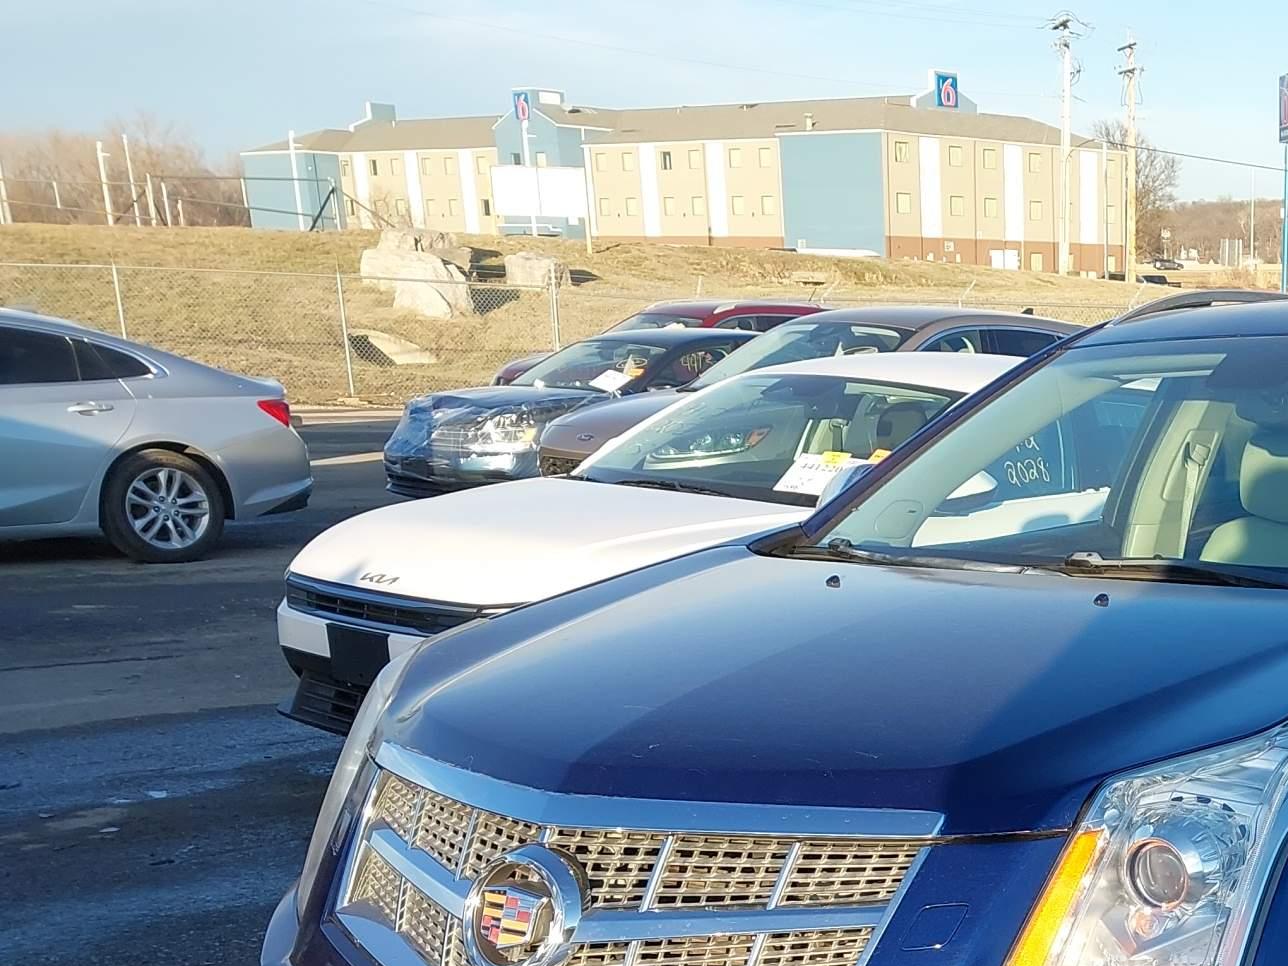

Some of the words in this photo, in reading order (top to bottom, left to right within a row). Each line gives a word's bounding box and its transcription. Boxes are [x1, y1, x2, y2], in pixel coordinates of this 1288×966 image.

[941, 78, 956, 106] 6
[1004, 457, 1050, 488] 2028
[360, 571, 400, 586] KIA
